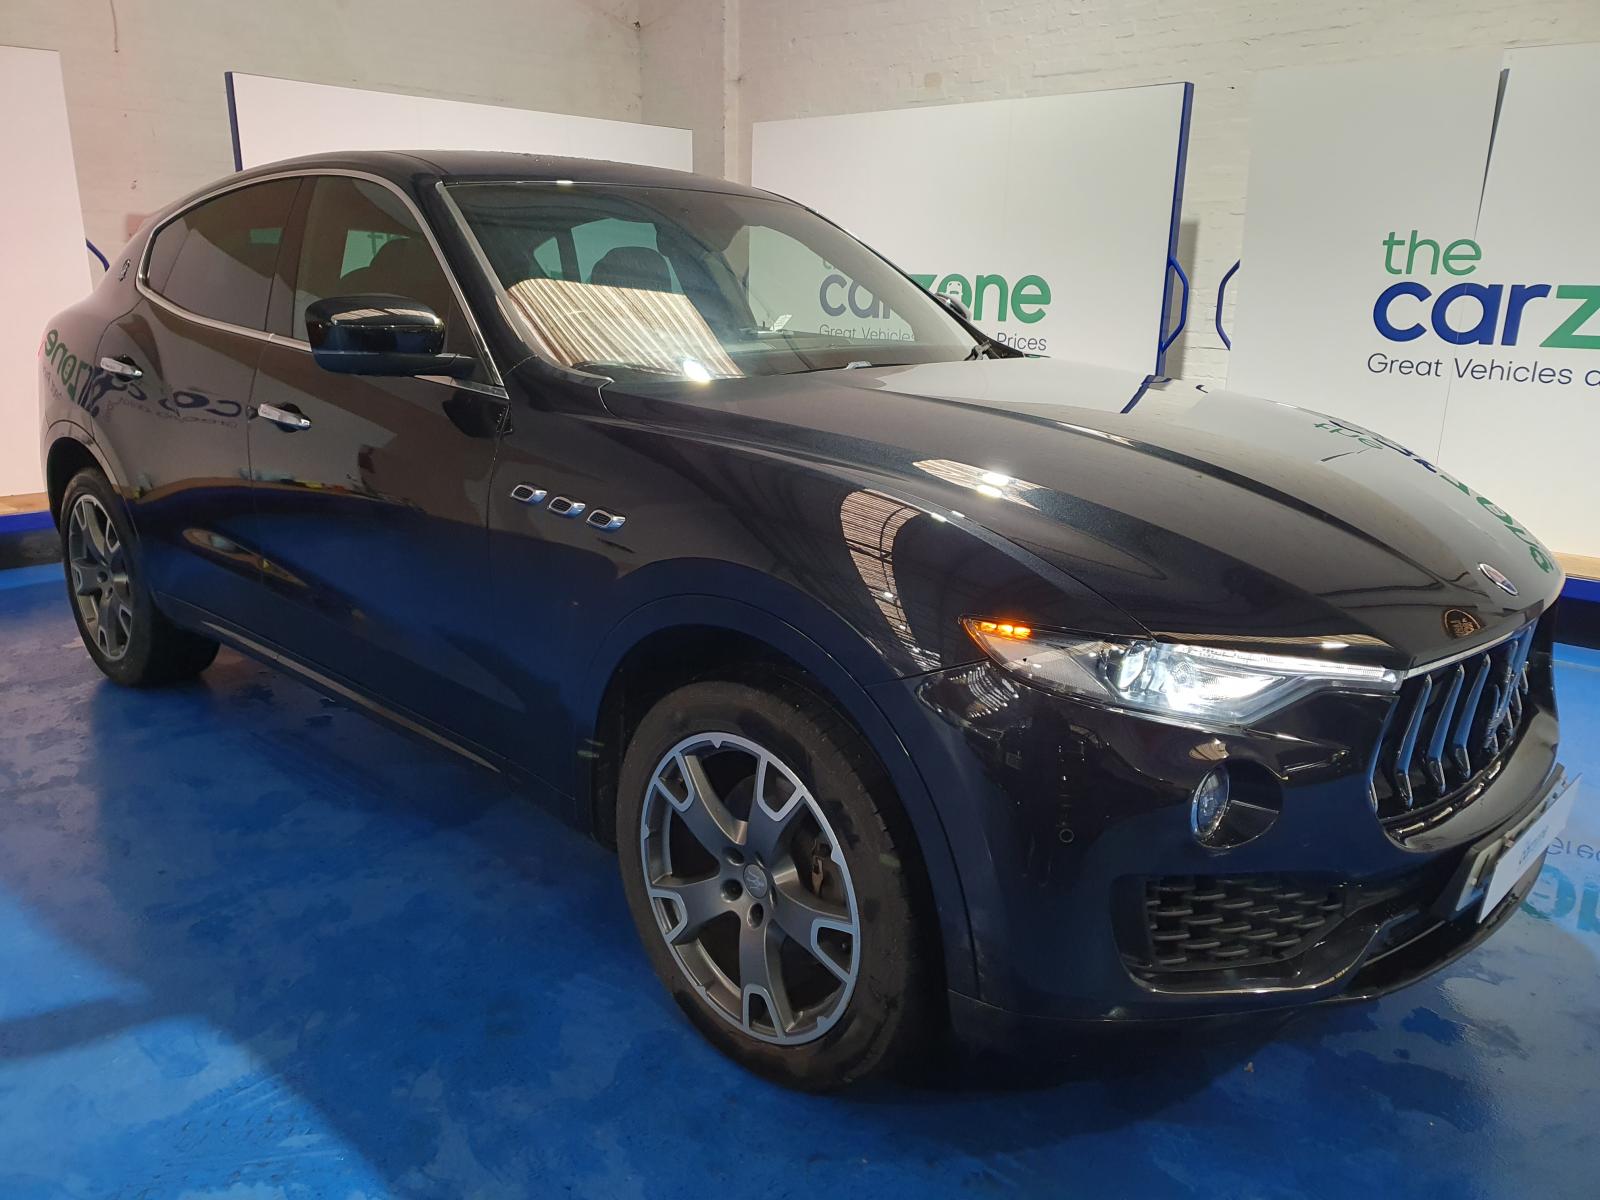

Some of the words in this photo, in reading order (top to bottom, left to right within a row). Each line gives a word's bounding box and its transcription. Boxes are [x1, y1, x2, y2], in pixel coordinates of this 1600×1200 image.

[1382, 229, 1482, 276] the
[996, 332, 1047, 351] Prices
[1367, 352, 1443, 378] Great
[1454, 357, 1573, 385] Vehicles
